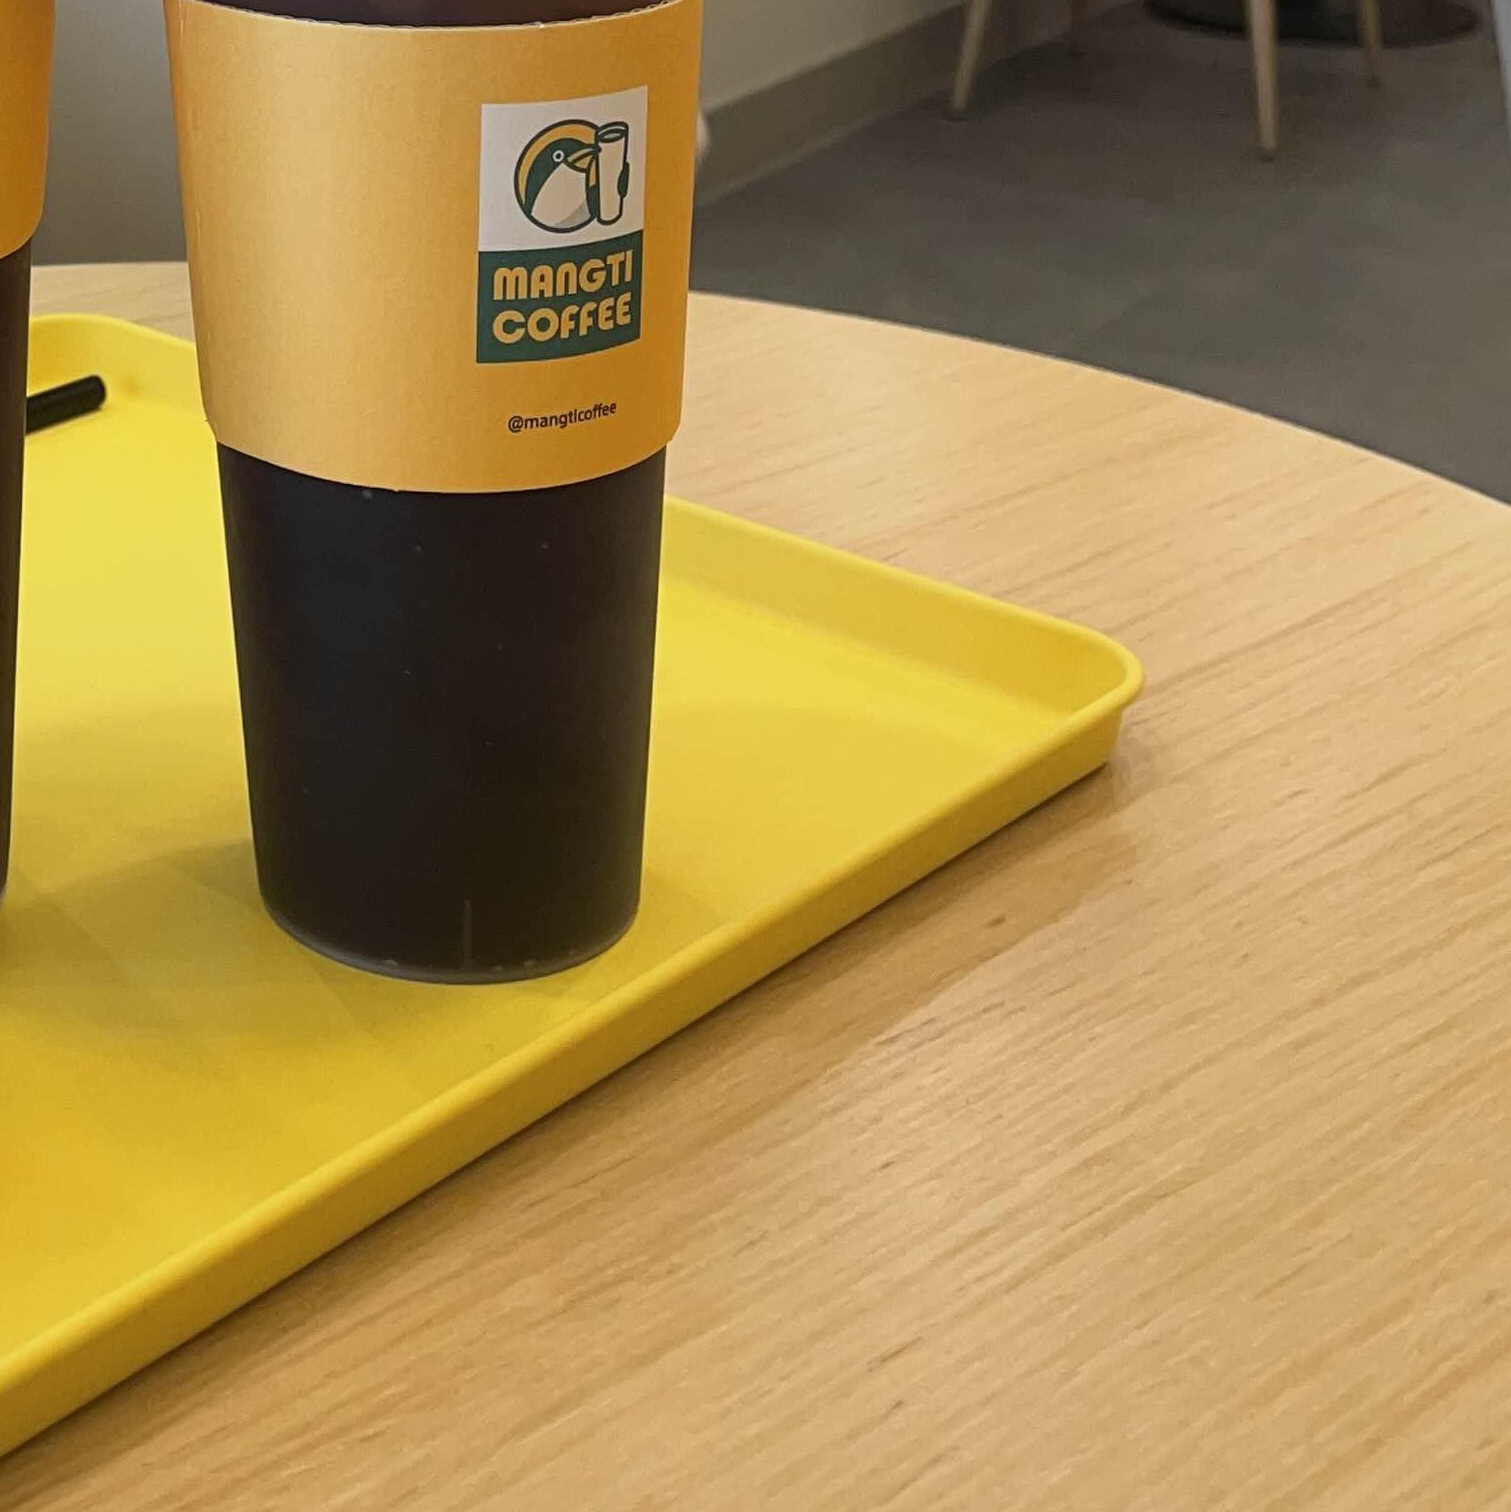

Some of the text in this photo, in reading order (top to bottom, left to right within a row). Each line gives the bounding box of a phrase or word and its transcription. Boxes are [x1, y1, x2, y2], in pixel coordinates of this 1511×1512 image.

[493, 250, 633, 301] MANGTI
[492, 292, 631, 344] COFFEE
[508, 402, 617, 433] @mangticoffee
